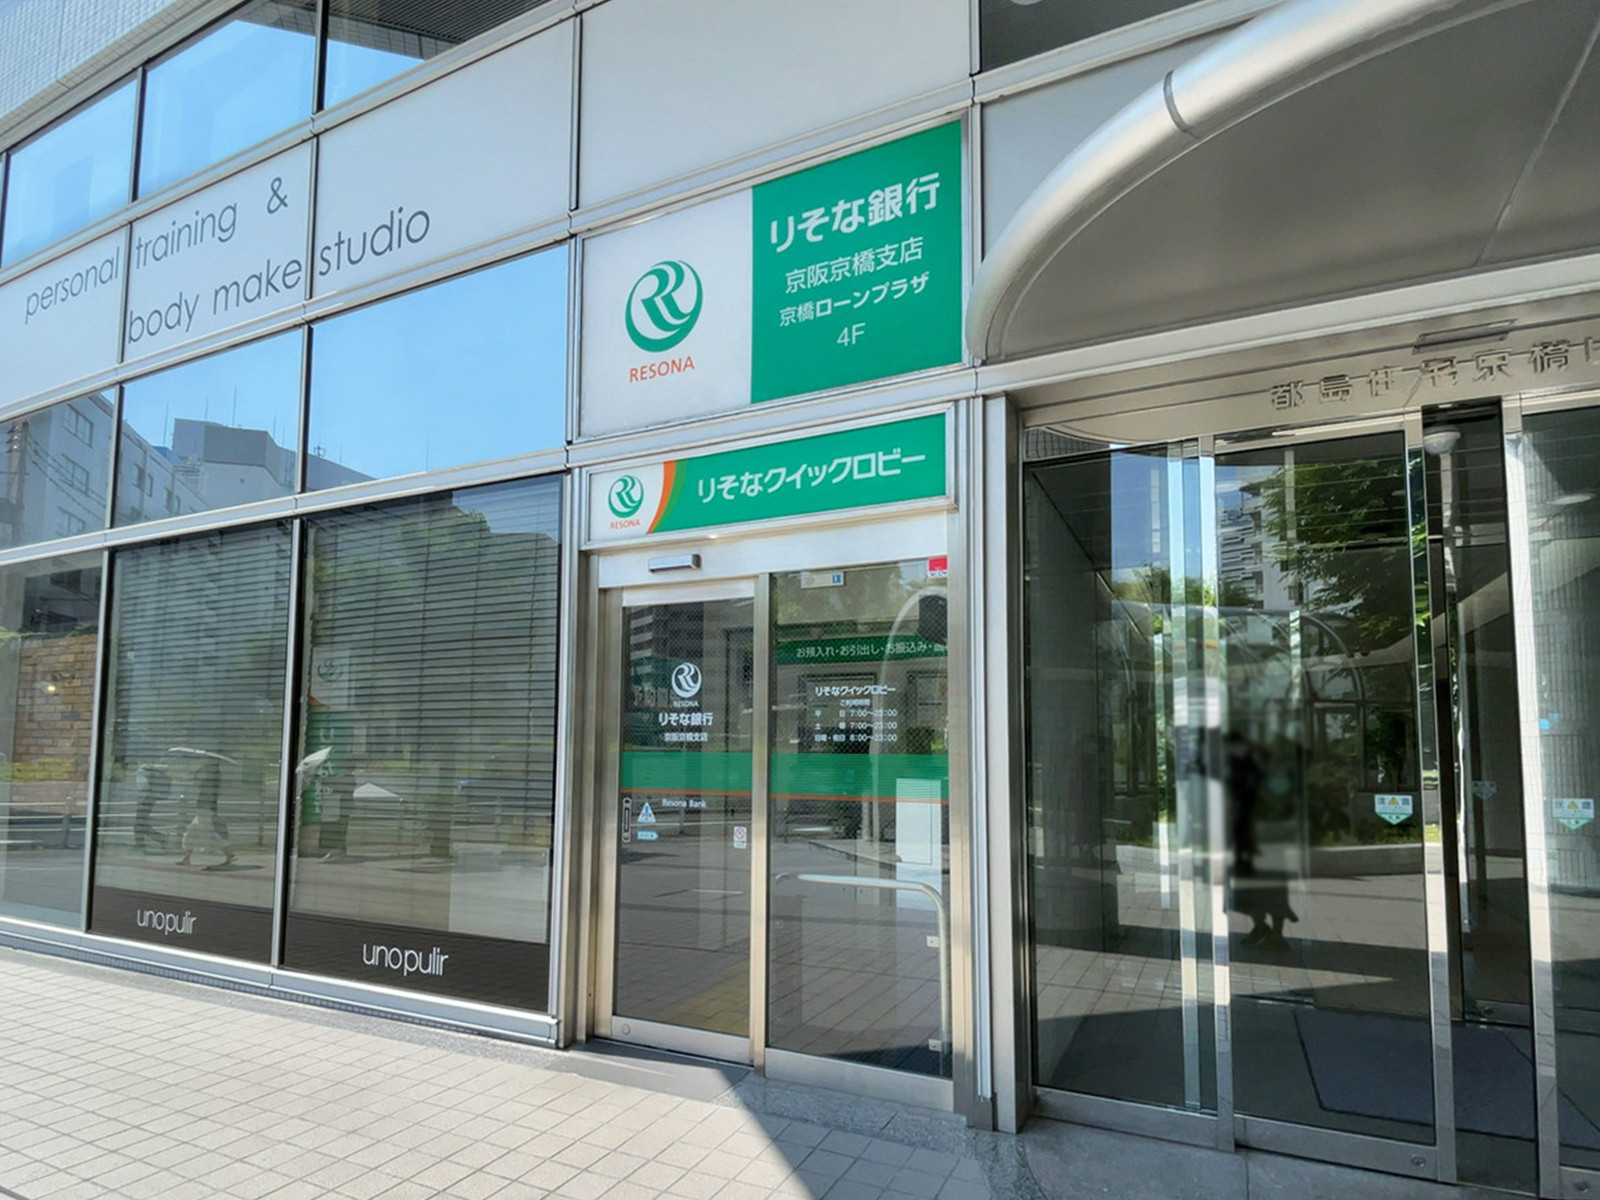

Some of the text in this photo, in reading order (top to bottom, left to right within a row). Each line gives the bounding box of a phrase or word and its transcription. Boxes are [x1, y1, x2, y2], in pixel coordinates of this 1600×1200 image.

[770, 172, 940, 253] りそな銀行
[24, 176, 289, 324] personal training &
[785, 236, 924, 294] 京阪京橋支店
[128, 206, 431, 345] body make studio
[779, 271, 931, 327] 京橋ローンプラザ
[836, 322, 866, 347] 4F
[629, 355, 695, 383] RESONA
[698, 447, 926, 504] りそなクイックロビー
[610, 518, 641, 530] RESONA
[658, 711, 714, 726] りそな銀行
[662, 798, 707, 809] Resona Bank
[136, 907, 197, 937] unopulir
[362, 943, 450, 977] unopulir
